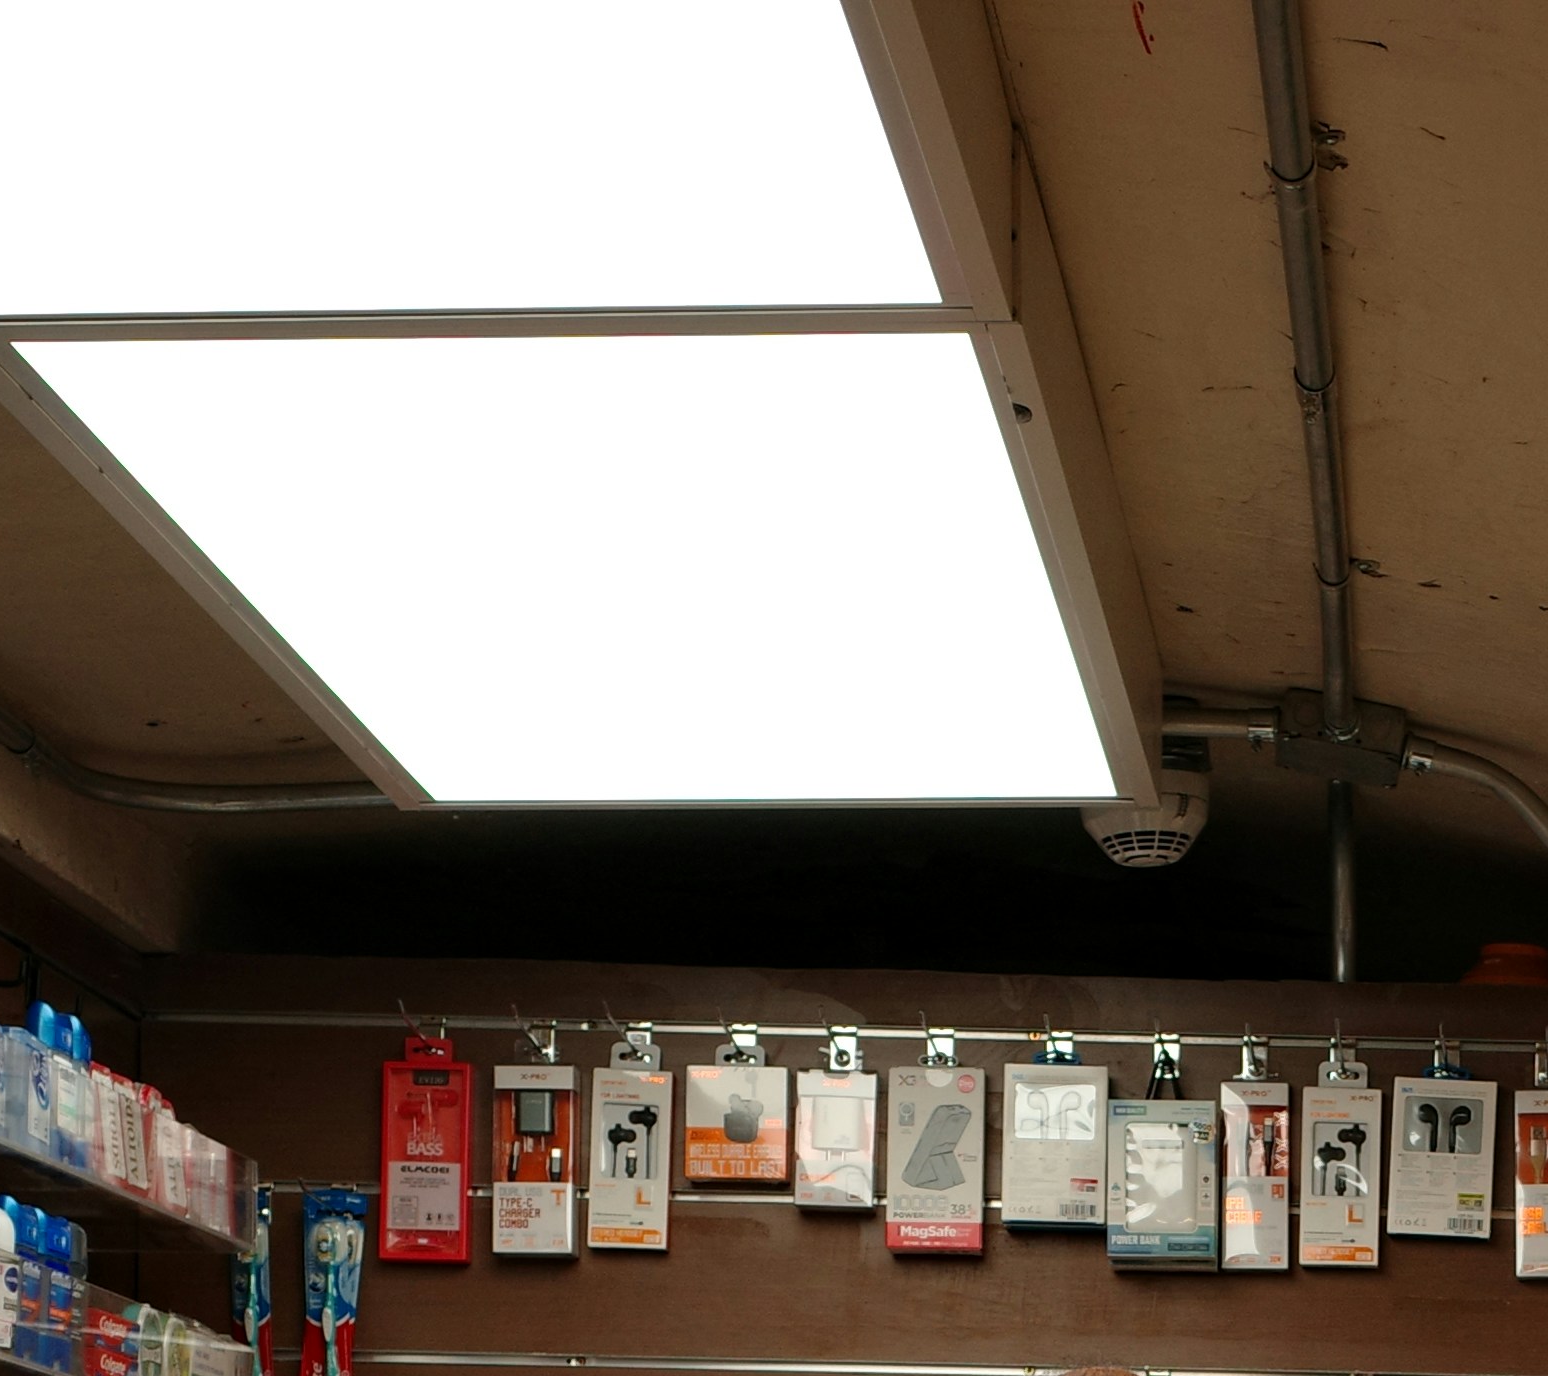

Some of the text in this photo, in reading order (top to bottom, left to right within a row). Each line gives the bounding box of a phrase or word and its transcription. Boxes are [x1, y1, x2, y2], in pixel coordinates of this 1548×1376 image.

[406, 1142, 444, 1156] BASS
[498, 1208, 541, 1219] CHARGER
[498, 1218, 529, 1229] COMBO
[899, 1224, 957, 1239] MagSafe
[1111, 1234, 1161, 1246] POWER BANK
